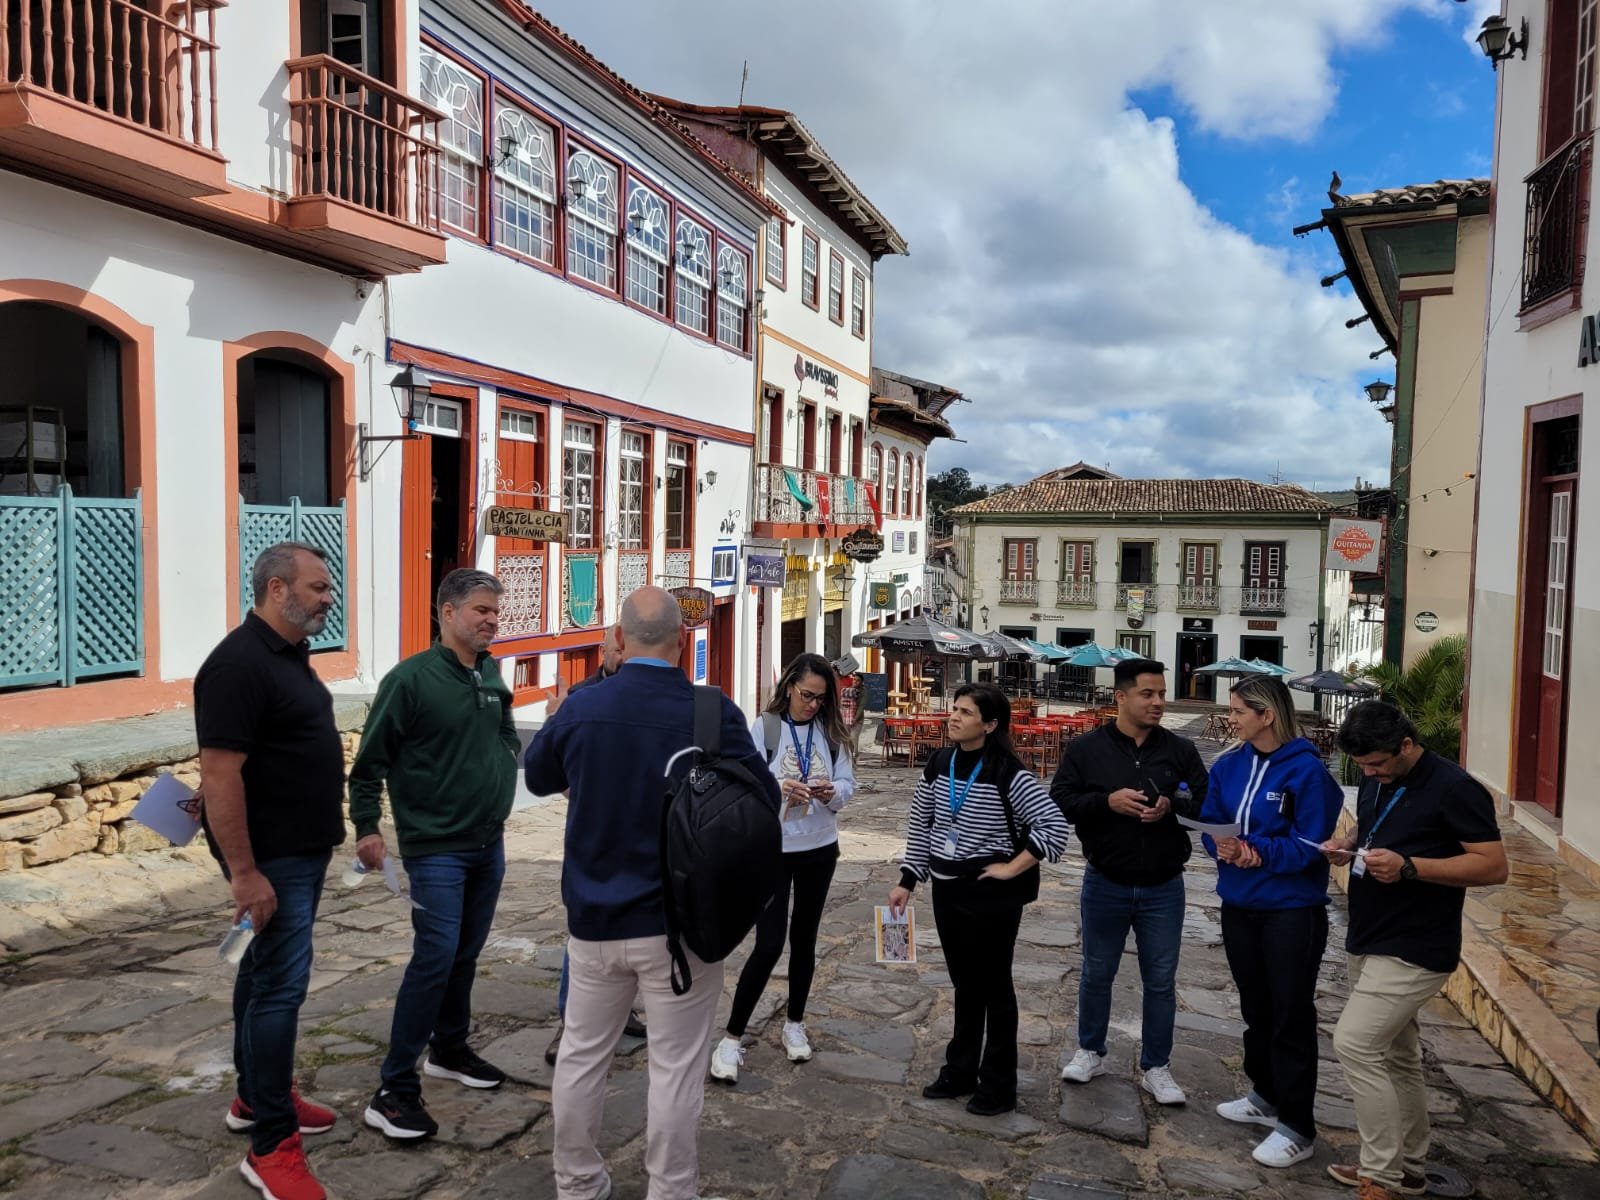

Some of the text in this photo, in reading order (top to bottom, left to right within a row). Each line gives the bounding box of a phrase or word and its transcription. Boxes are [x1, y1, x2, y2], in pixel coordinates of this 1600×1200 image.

[490, 509, 534, 525] PASTEL
[1336, 540, 1371, 549] QUITANDA
[893, 639, 924, 648] AMSTEL
